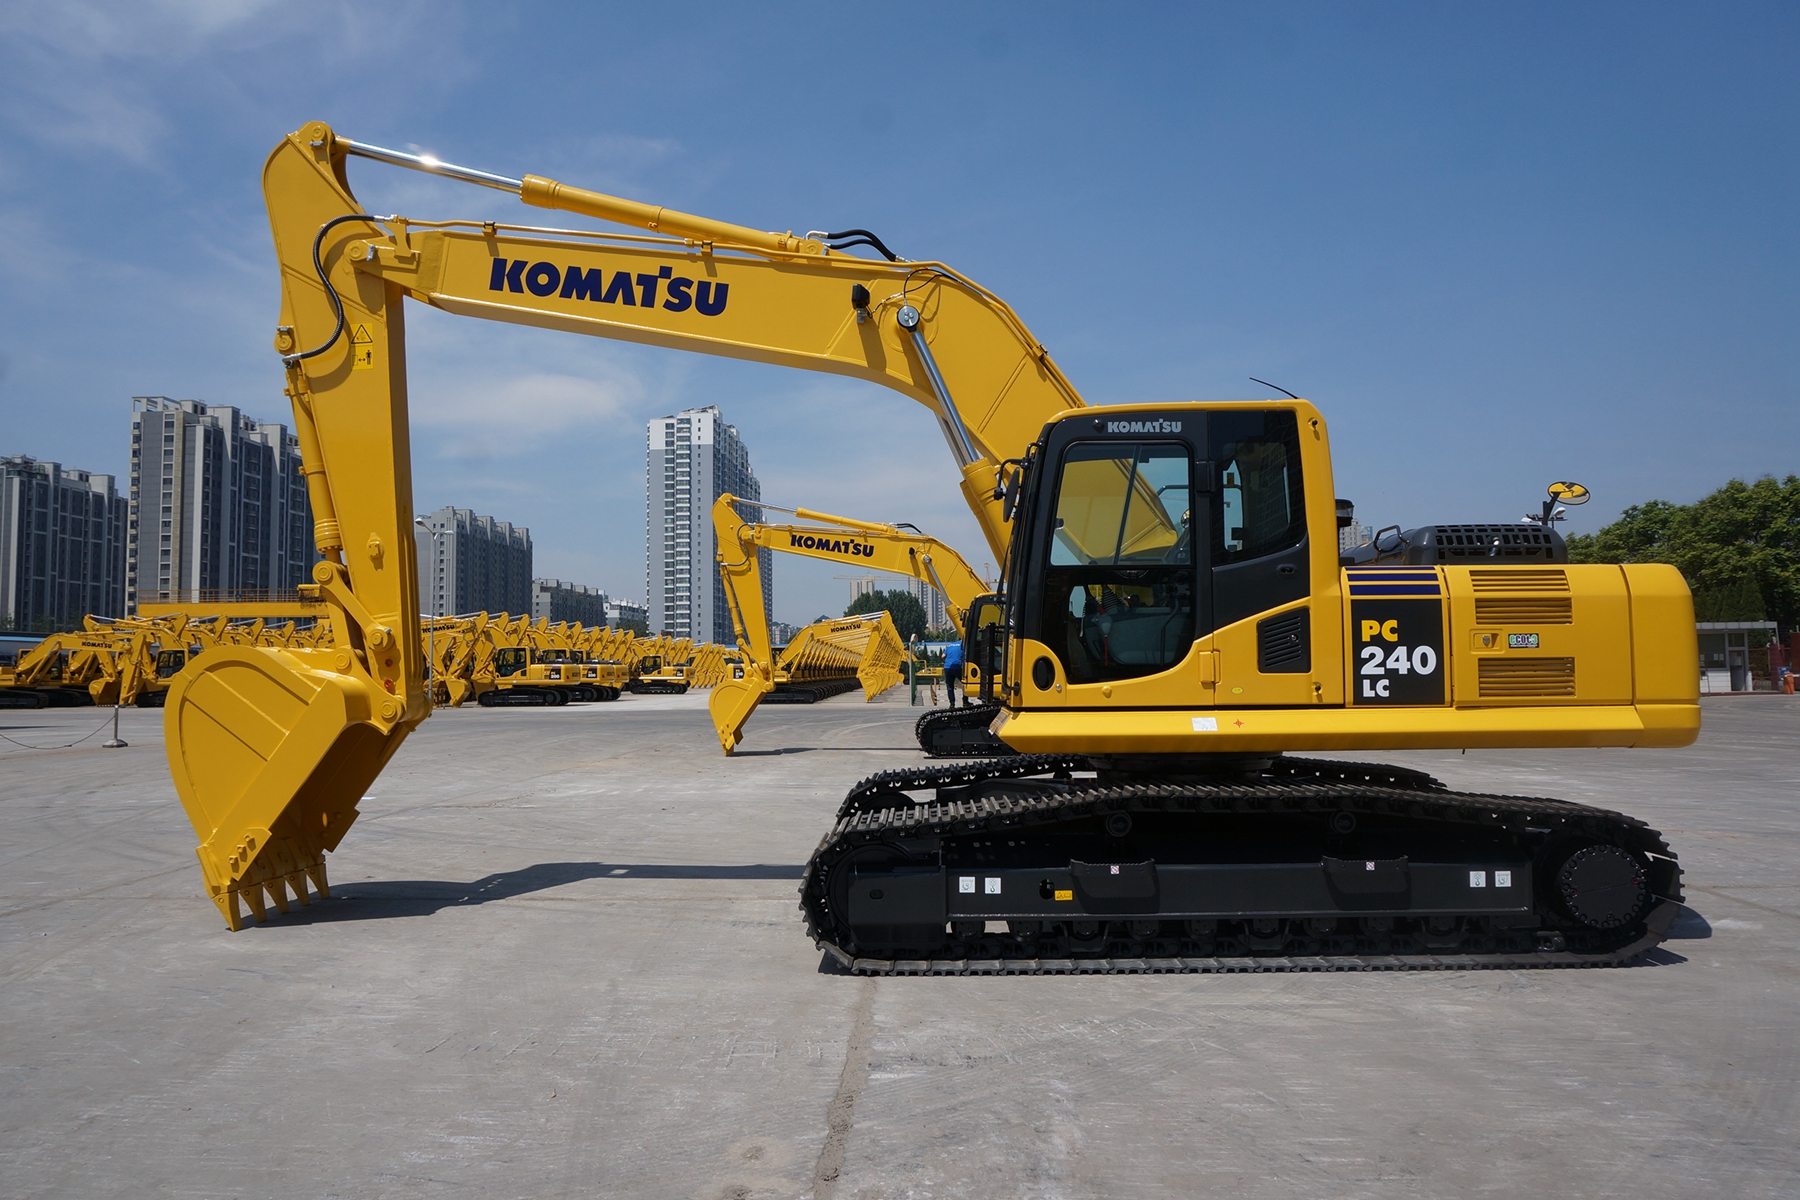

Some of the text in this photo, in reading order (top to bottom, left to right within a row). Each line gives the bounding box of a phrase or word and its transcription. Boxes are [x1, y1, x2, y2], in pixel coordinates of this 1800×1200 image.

[489, 257, 729, 317] KOMATSU
[1107, 419, 1182, 433] KOMATSU
[790, 534, 874, 558] KOMATSU
[830, 623, 861, 633] KOMATSU
[1361, 619, 1398, 642] PC
[81, 641, 112, 649] KOMATSU
[1509, 634, 1538, 645] ecot3
[1360, 645, 1437, 676] 240
[1362, 679, 1390, 698] LC
